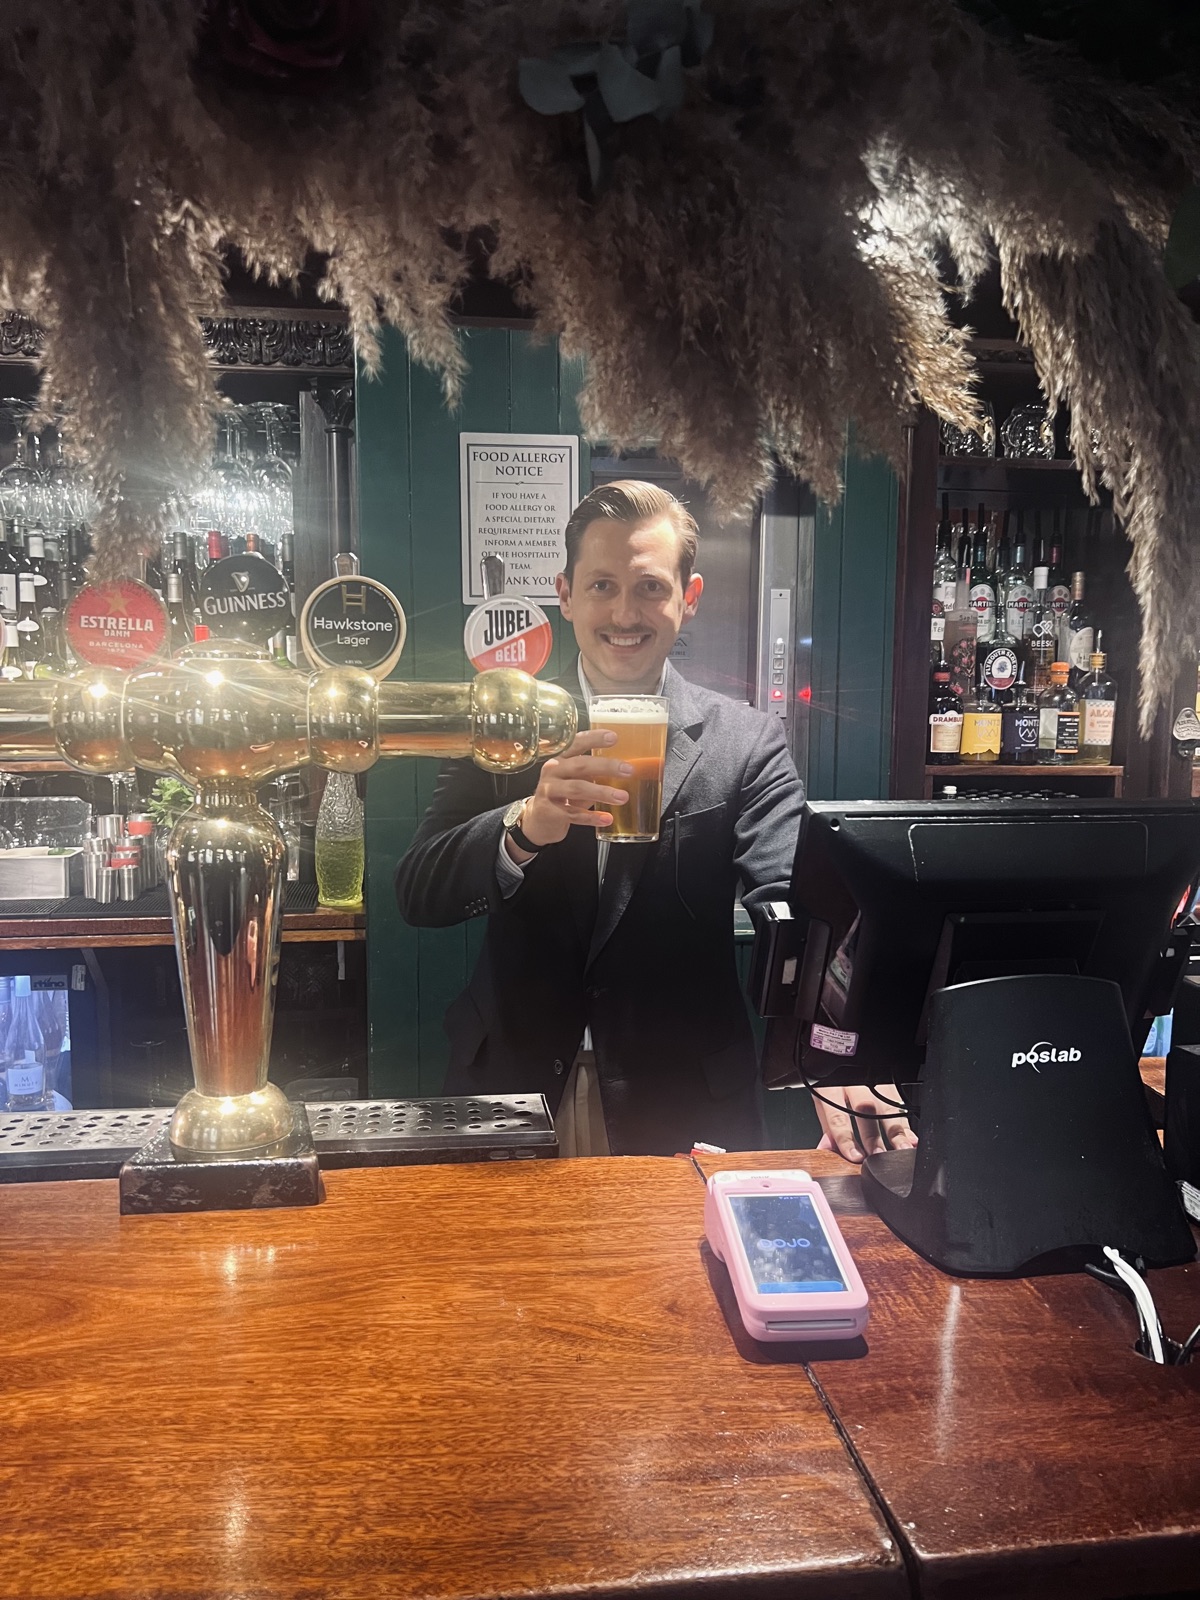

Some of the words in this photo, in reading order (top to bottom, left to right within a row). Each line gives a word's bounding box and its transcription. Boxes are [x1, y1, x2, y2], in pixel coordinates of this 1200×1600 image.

[473, 451, 509, 462] FOOD
[512, 452, 566, 464] ALLERGY
[495, 465, 543, 477] NOTICE
[501, 492, 518, 500] YOU
[485, 503, 508, 511] FOOD
[509, 504, 542, 512] ALLERGY
[484, 515, 491, 523] A
[492, 515, 522, 524] SPECIAL
[523, 516, 556, 524] DIETARY
[478, 527, 534, 536] REQUIREMENT
[535, 528, 561, 536] PLEASE
[484, 539, 516, 547] INFORM
[525, 540, 557, 548] MEMBER
[493, 551, 509, 559] THE
[511, 551, 561, 559] HOSPITALITY
[505, 576, 531, 586] ANK
[532, 576, 555, 586] YOU
[203, 591, 286, 616] GUINNESS
[80, 615, 154, 632] ESTRELLA
[313, 616, 393, 632] Hawkstone
[483, 609, 533, 647] JUBEL
[104, 629, 131, 638] DAMM
[88, 641, 144, 649] BARCELONA
[336, 633, 371, 647] Lager
[495, 638, 526, 663] BEER
[985, 650, 1006, 676] PLYMOUTH
[1011, 1043, 1082, 1071] poslab
[758, 1238, 811, 1249] DOJO
